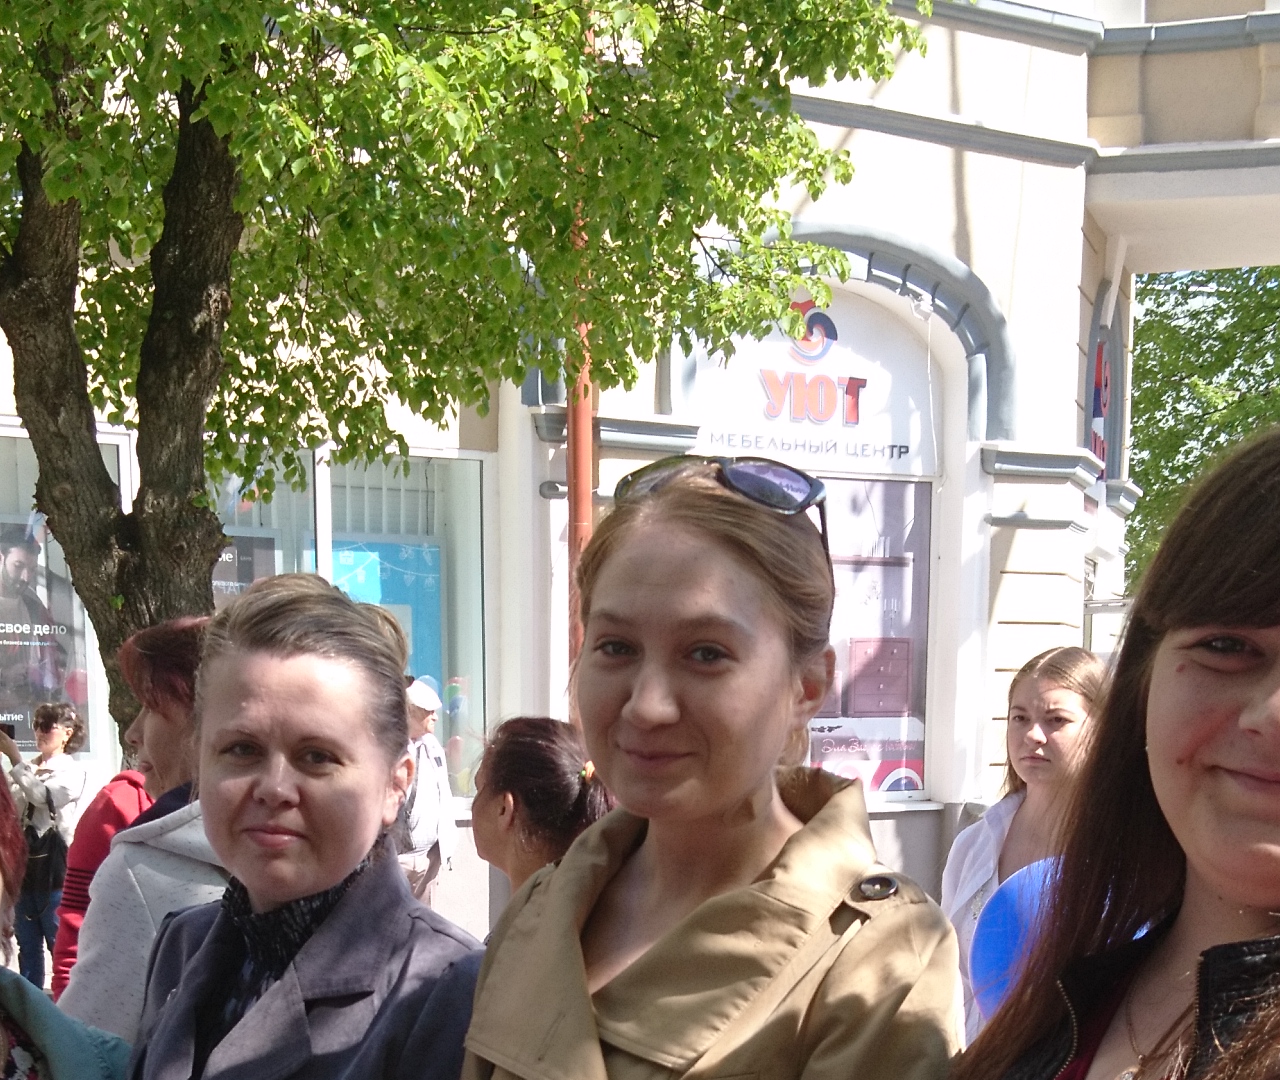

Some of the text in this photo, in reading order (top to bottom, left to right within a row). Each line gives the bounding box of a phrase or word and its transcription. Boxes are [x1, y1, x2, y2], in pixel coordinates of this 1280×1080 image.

[760, 369, 868, 426] УЮТ
[710, 432, 909, 459] МЕБЕЛЬНЫЙ ЦЕНТР
[33, 624, 66, 636] дело
